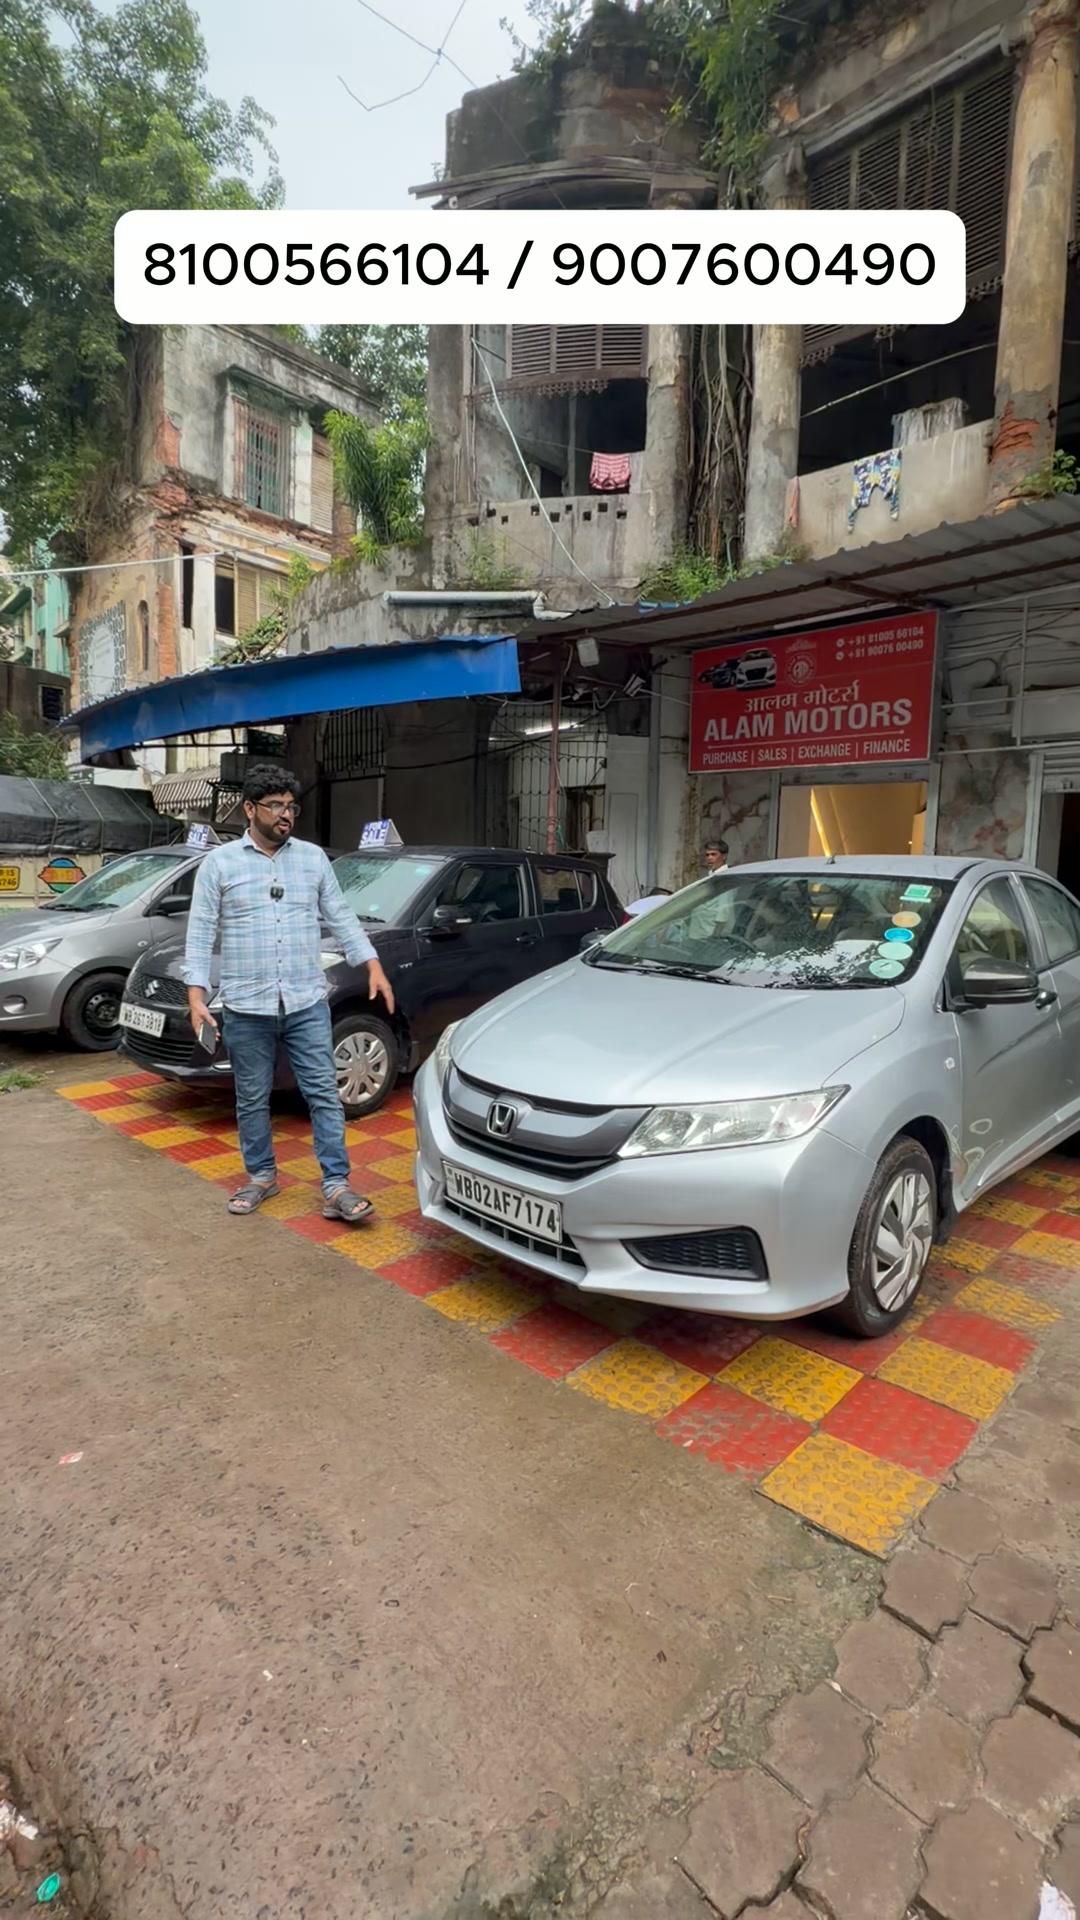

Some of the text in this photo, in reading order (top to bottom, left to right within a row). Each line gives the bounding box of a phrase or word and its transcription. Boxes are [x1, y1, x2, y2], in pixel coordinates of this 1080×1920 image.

[848, 625, 924, 646] +91 81005 66104
[848, 638, 924, 659] +91 90076 00490
[745, 679, 860, 714] आलम मोटर्स
[703, 698, 913, 742] ALAM MOTORS
[703, 738, 911, 765] PURCHASE SALES EXCHANGE FINANCE
[187, 831, 207, 844] SALE
[361, 829, 386, 843] SALE
[454, 1172, 557, 1234] WB02AF7174
